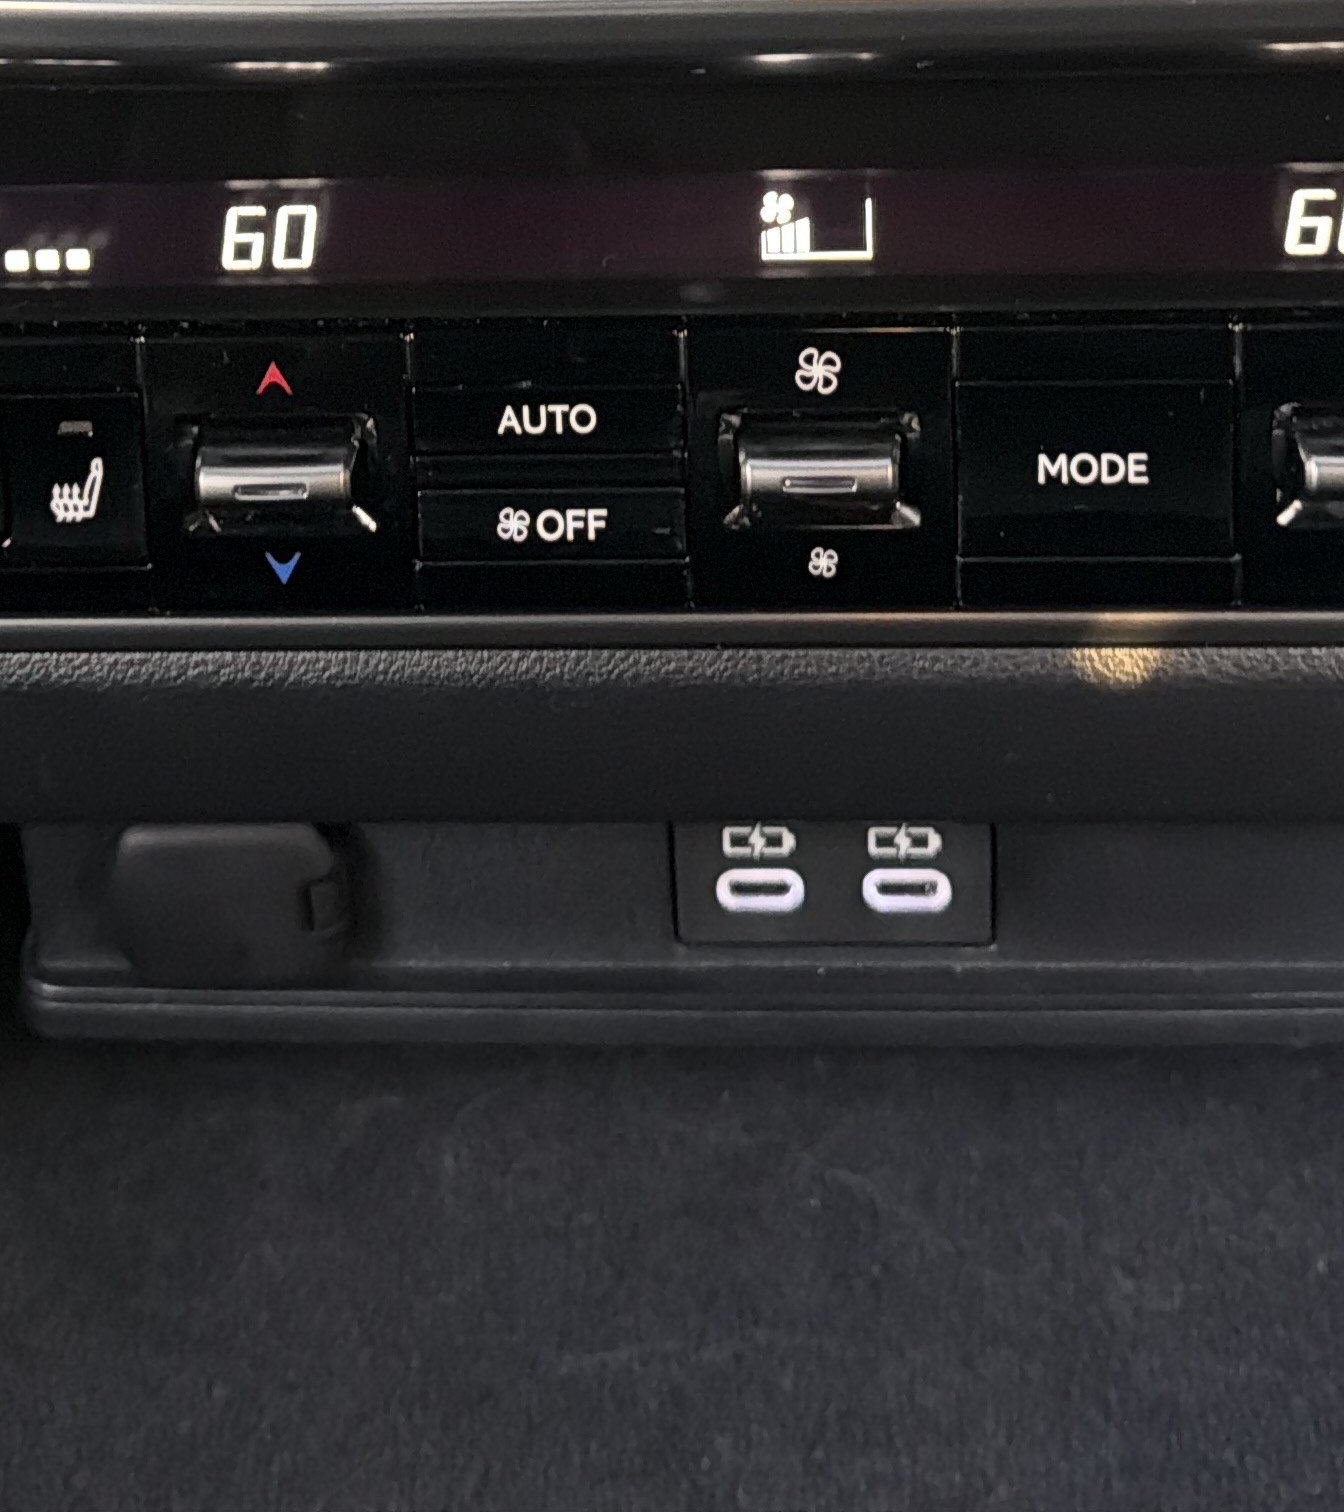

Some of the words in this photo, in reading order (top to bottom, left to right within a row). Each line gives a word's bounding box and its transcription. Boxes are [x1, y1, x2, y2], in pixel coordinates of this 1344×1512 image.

[221, 204, 318, 271] 60
[497, 403, 598, 435] AUTO
[1037, 452, 1150, 485] MODE
[536, 508, 609, 542] OFF
